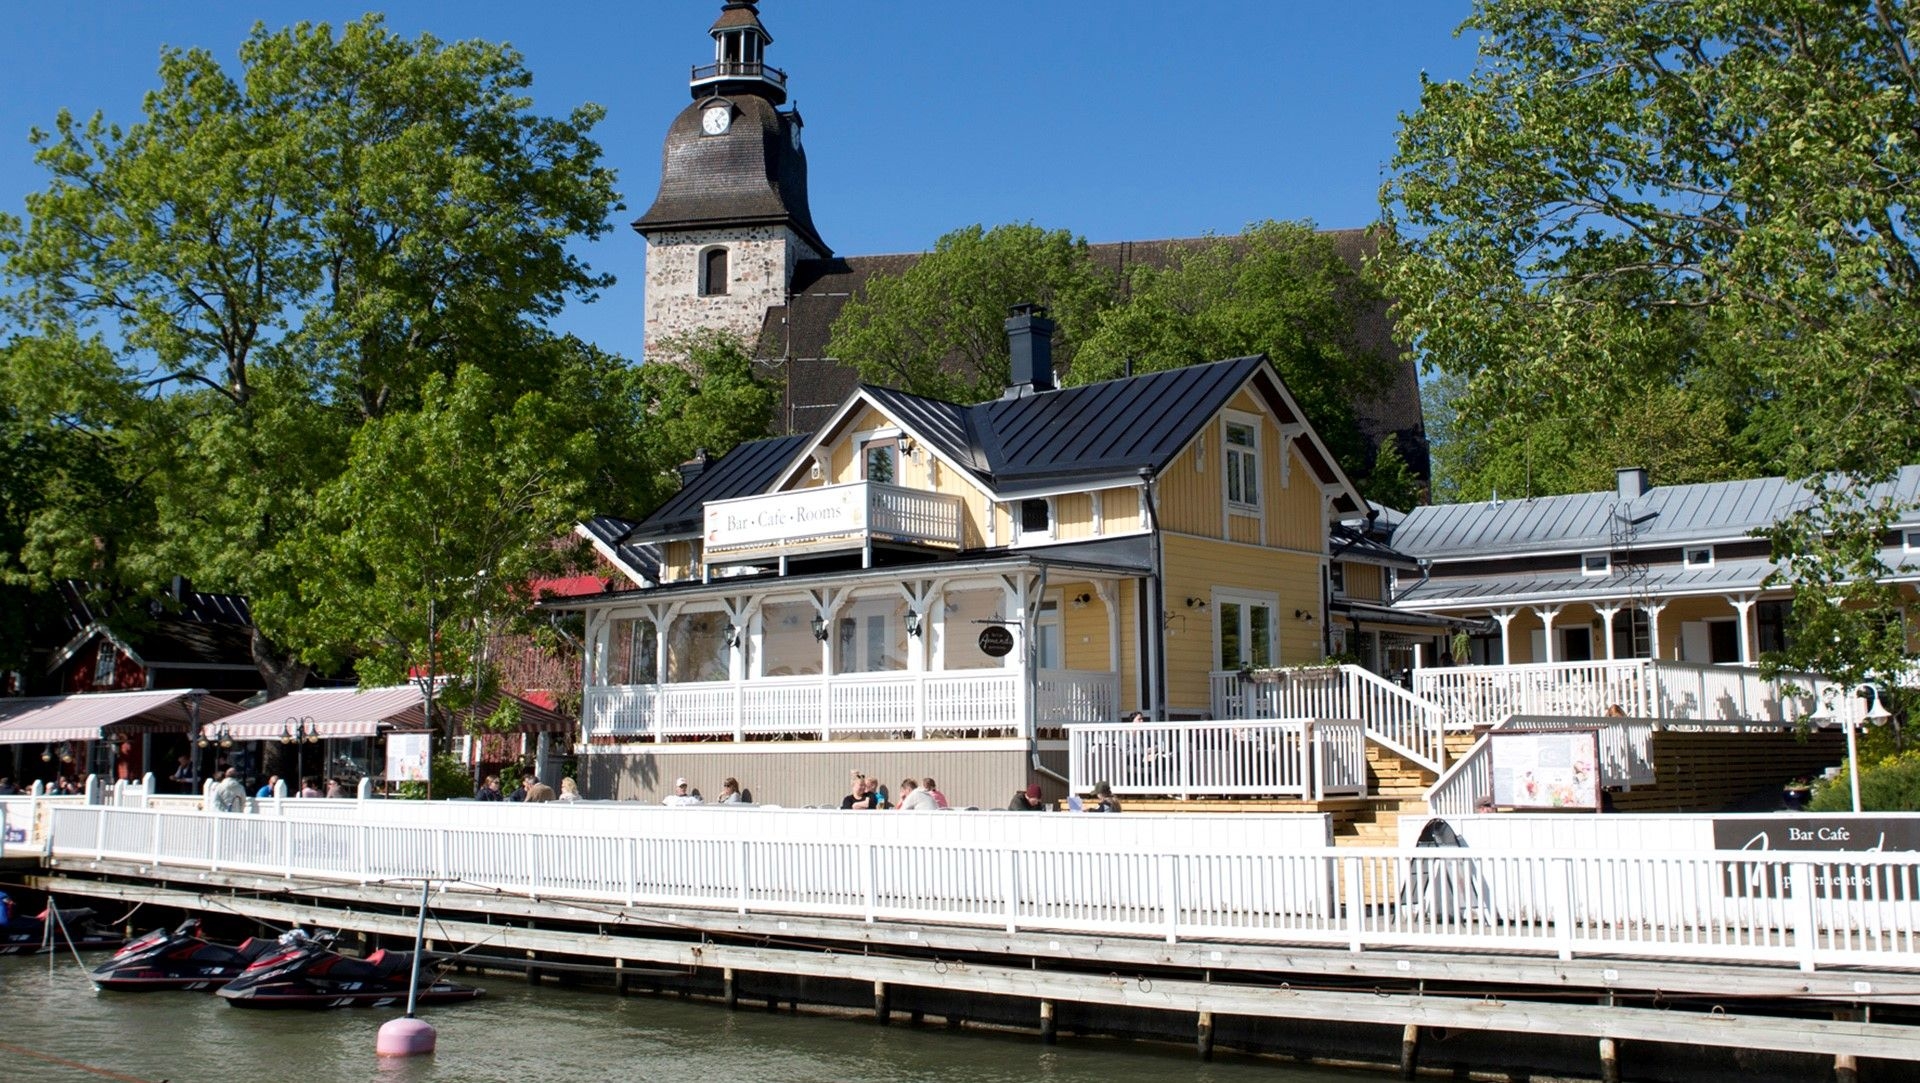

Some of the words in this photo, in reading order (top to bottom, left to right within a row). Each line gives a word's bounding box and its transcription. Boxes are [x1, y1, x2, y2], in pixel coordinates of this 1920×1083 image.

[727, 514, 748, 532] Bar
[796, 506, 842, 523] Rooms
[1789, 827, 1814, 841] Bar
[1817, 827, 1850, 841] Cafe
